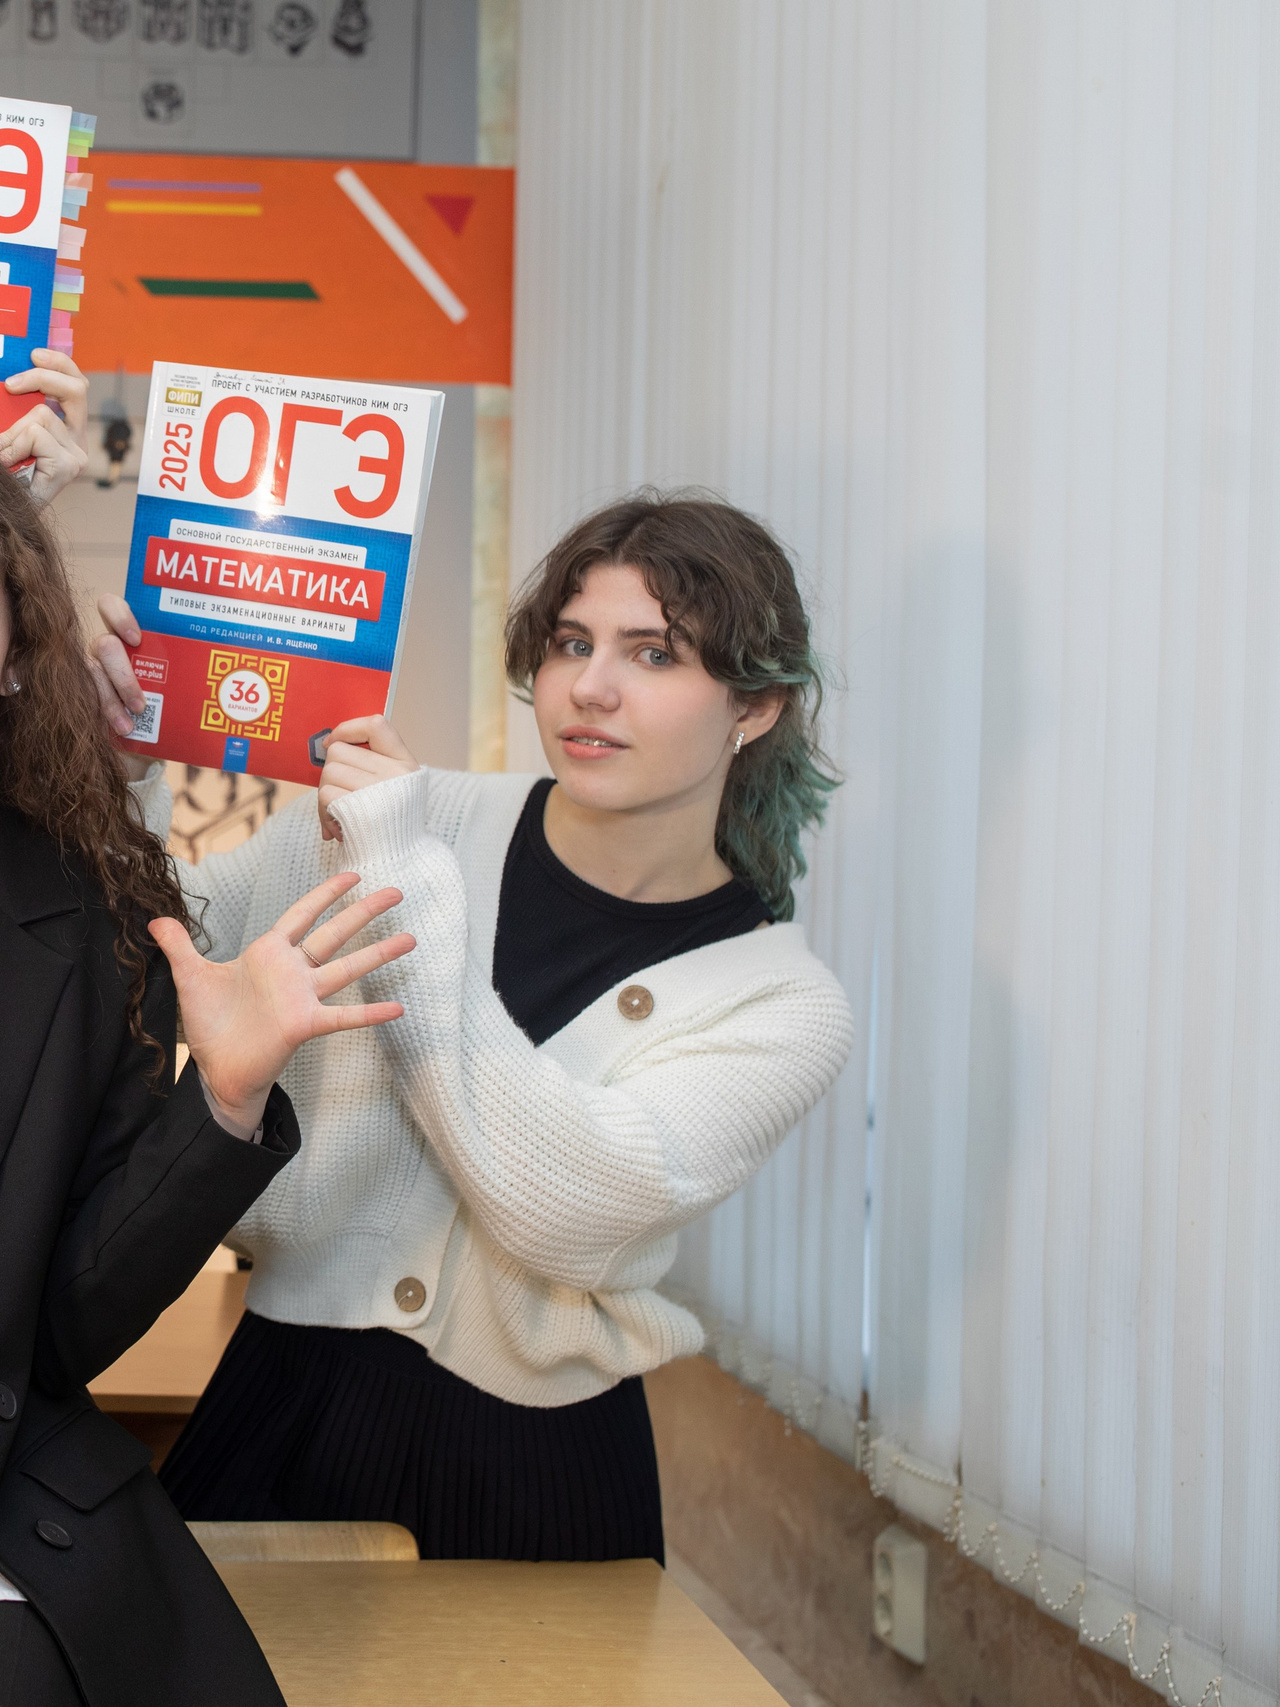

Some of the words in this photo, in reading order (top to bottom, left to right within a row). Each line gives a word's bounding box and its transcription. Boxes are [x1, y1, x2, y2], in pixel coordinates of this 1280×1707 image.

[6, 114, 24, 124] КИМ
[28, 117, 44, 127] ОГЭ
[167, 390, 199, 404] ФИПИ
[211, 379, 241, 390] ПРОЕКТ
[245, 384, 251, 392] С
[254, 385, 296, 398] УЧАСТИЕМ
[300, 390, 367, 407] РАЗРАБОТЧИКОВ
[371, 399, 389, 409] КИМ
[392, 402, 408, 412] ОГЭ
[167, 405, 196, 416] ШКОЛЕ
[159, 421, 192, 492] 2025
[199, 396, 405, 518] ОГЭ
[175, 526, 221, 540] ОСНОВНОЙ
[225, 533, 314, 555] ГОСУДАРСТВЕННЫЙ
[317, 547, 359, 561] ЭКЗАМЕН
[155, 548, 370, 609] МАТЕМАТИКА
[169, 596, 206, 610] ТИПОВЫЕ
[210, 602, 296, 624] ЭКЗАМЕНАЦИОННЫЕ
[301, 617, 346, 632] ВАРИАНТЫ
[189, 623, 207, 634] ПОД
[210, 626, 263, 642] РЕДАКЦИЕЙ
[285, 638, 317, 651] ЯЩЕНКО
[133, 666, 163, 679] oge.plus
[135, 659, 164, 670] включи
[228, 679, 261, 704] 36
[227, 703, 258, 713] ВАРИАНТОВ
